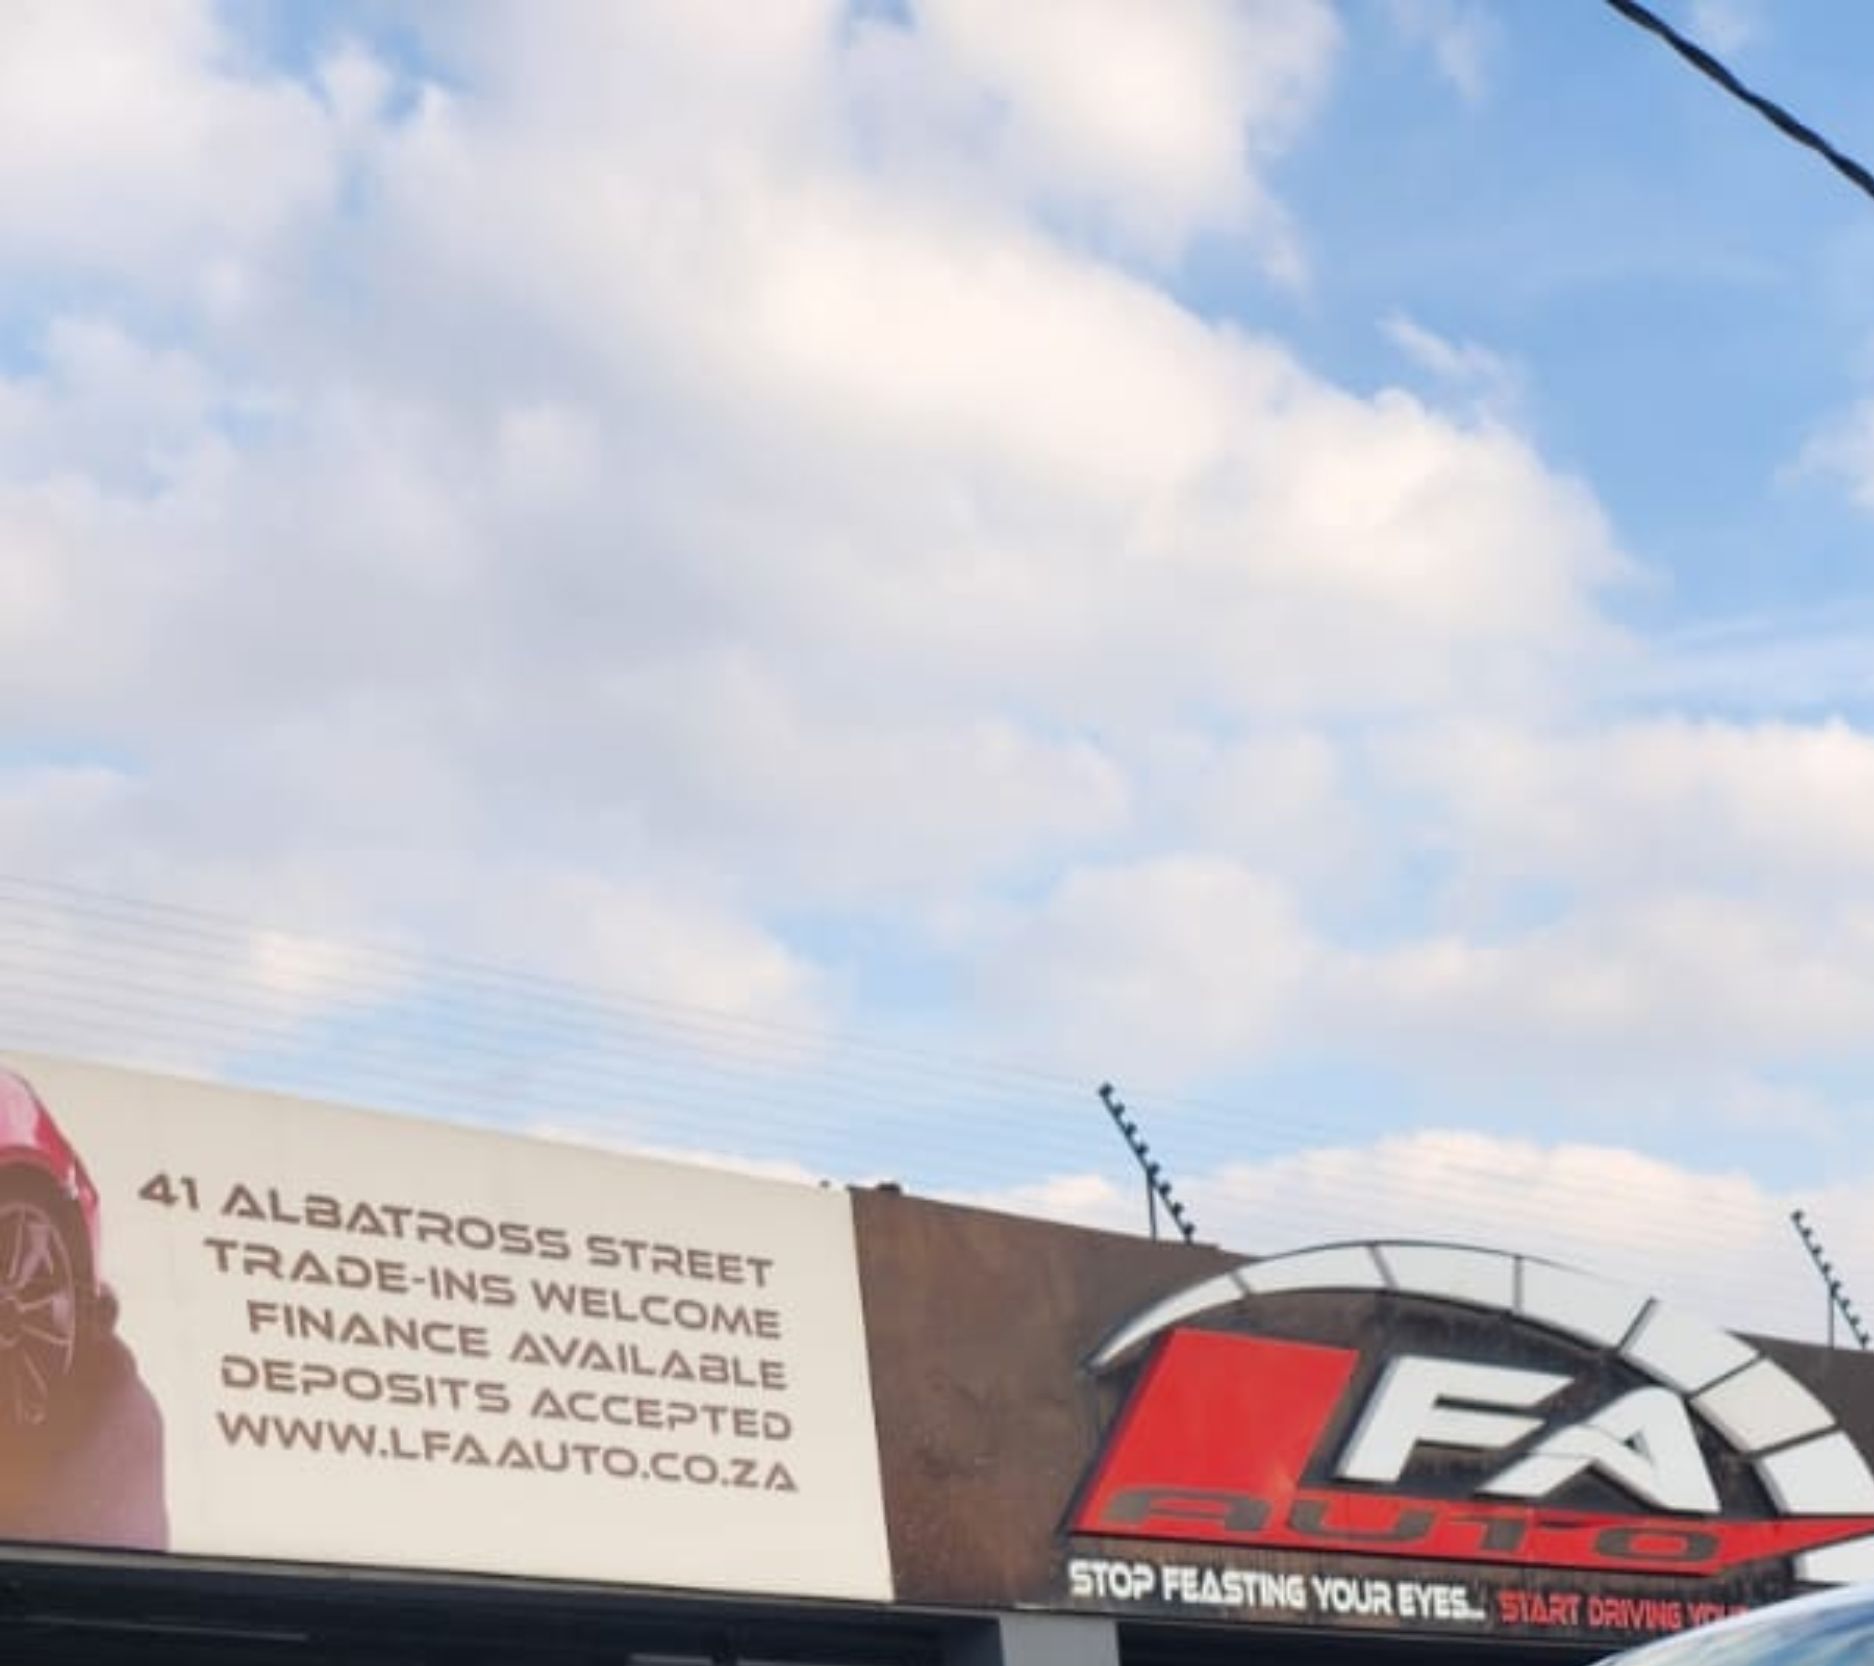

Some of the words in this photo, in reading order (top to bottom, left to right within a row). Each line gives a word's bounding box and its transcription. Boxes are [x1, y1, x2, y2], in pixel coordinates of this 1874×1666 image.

[138, 1172, 202, 1211] 41
[221, 1182, 572, 1260] ALBATROSS
[584, 1234, 775, 1288] STREET
[203, 1237, 517, 1306] TRADE-INS
[530, 1280, 783, 1341] WELCOME
[245, 1301, 490, 1359] FINANCE
[508, 1335, 789, 1392] AVAILABLE
[220, 1354, 511, 1416] DEPOSITS
[529, 1387, 793, 1442] ACCEPTED
[215, 1410, 799, 1494] WWW.LFAAUTO.CO.ZA
[1100, 1488, 1722, 1562] AUTO
[1068, 1558, 1154, 1600] STOP
[1161, 1564, 1306, 1610] FEASTING
[1311, 1574, 1393, 1617] YOUR
[1500, 1589, 1581, 1626] START
[1587, 1597, 1683, 1631] DRIVING
